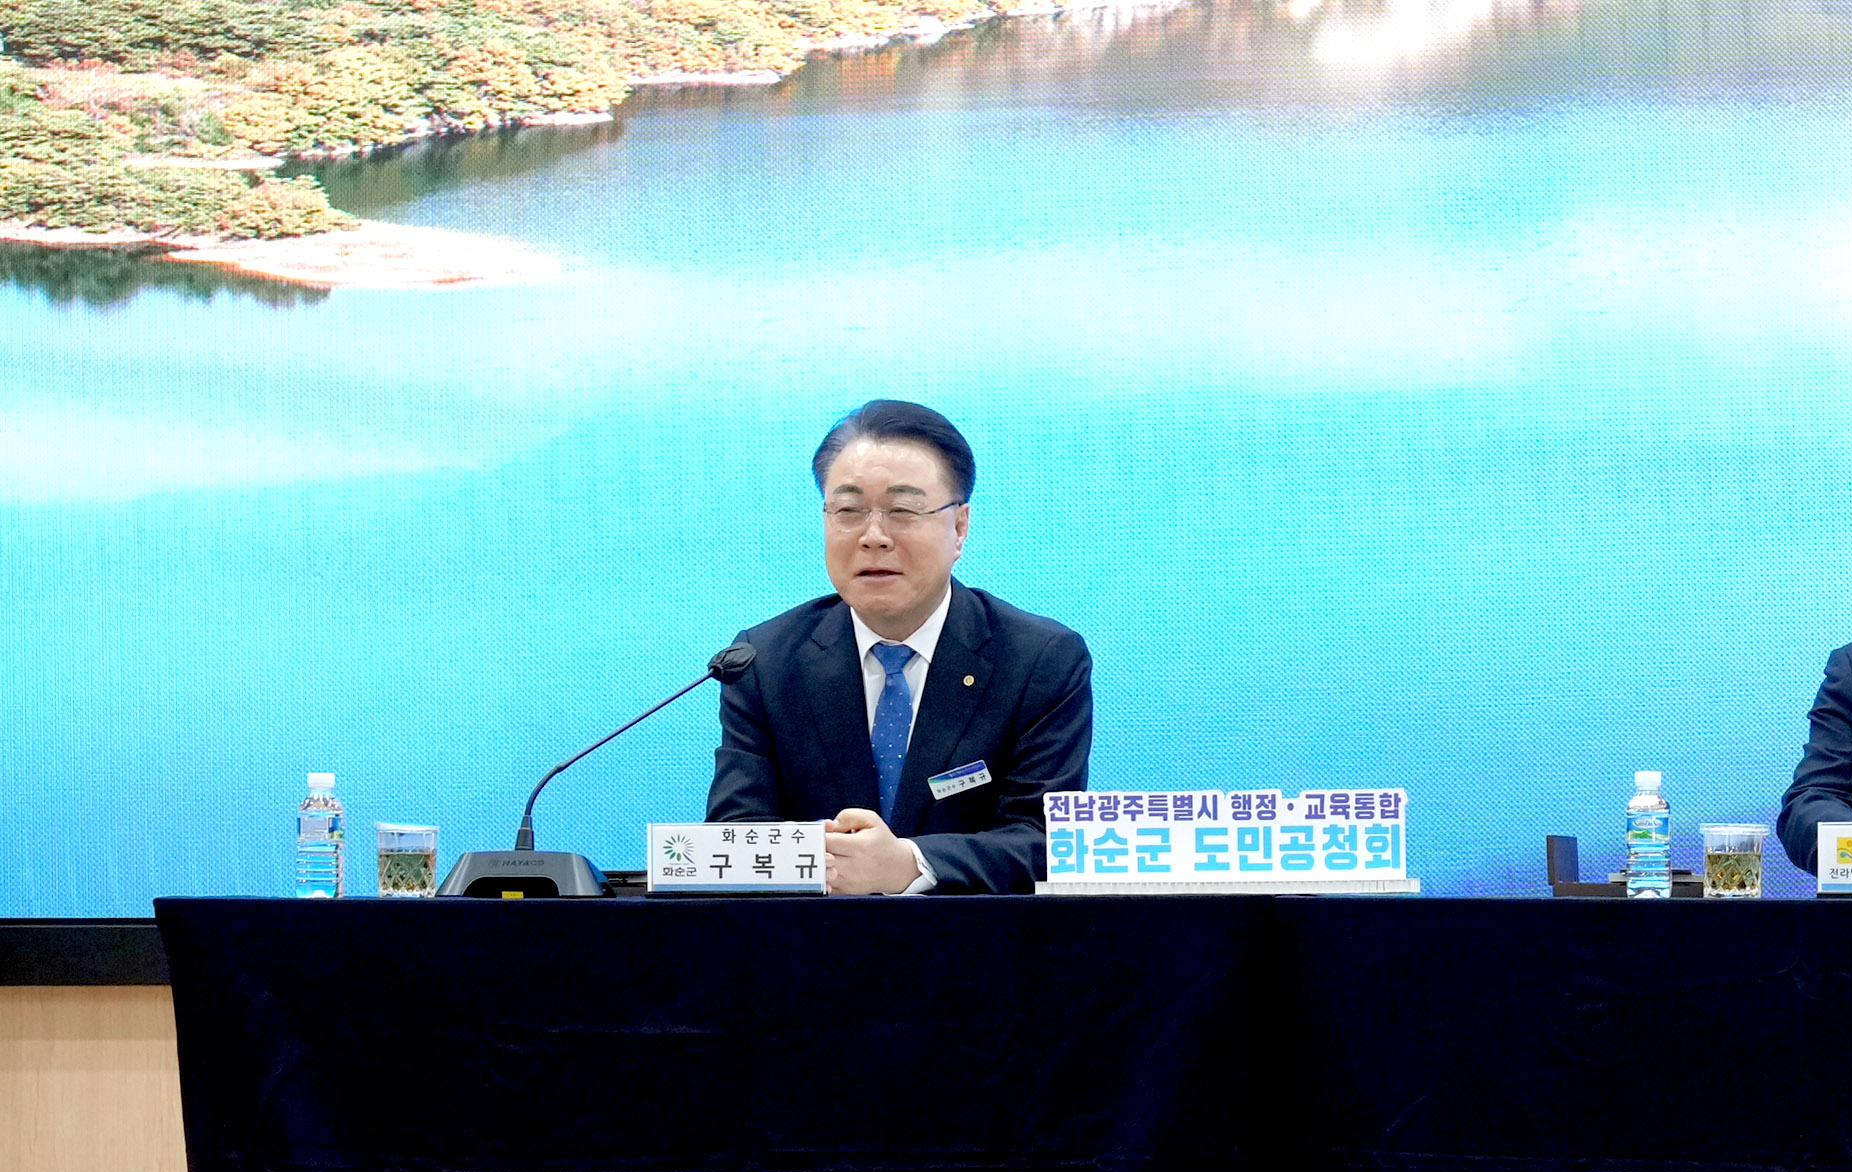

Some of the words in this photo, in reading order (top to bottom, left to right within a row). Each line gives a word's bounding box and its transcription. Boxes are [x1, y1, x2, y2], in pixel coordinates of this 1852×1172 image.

[1048, 795, 1219, 822] 전남광주특별시
[1049, 827, 1172, 874] 화순군
[1194, 823, 1402, 872] 도민공청회
[662, 867, 697, 877] 화순군
